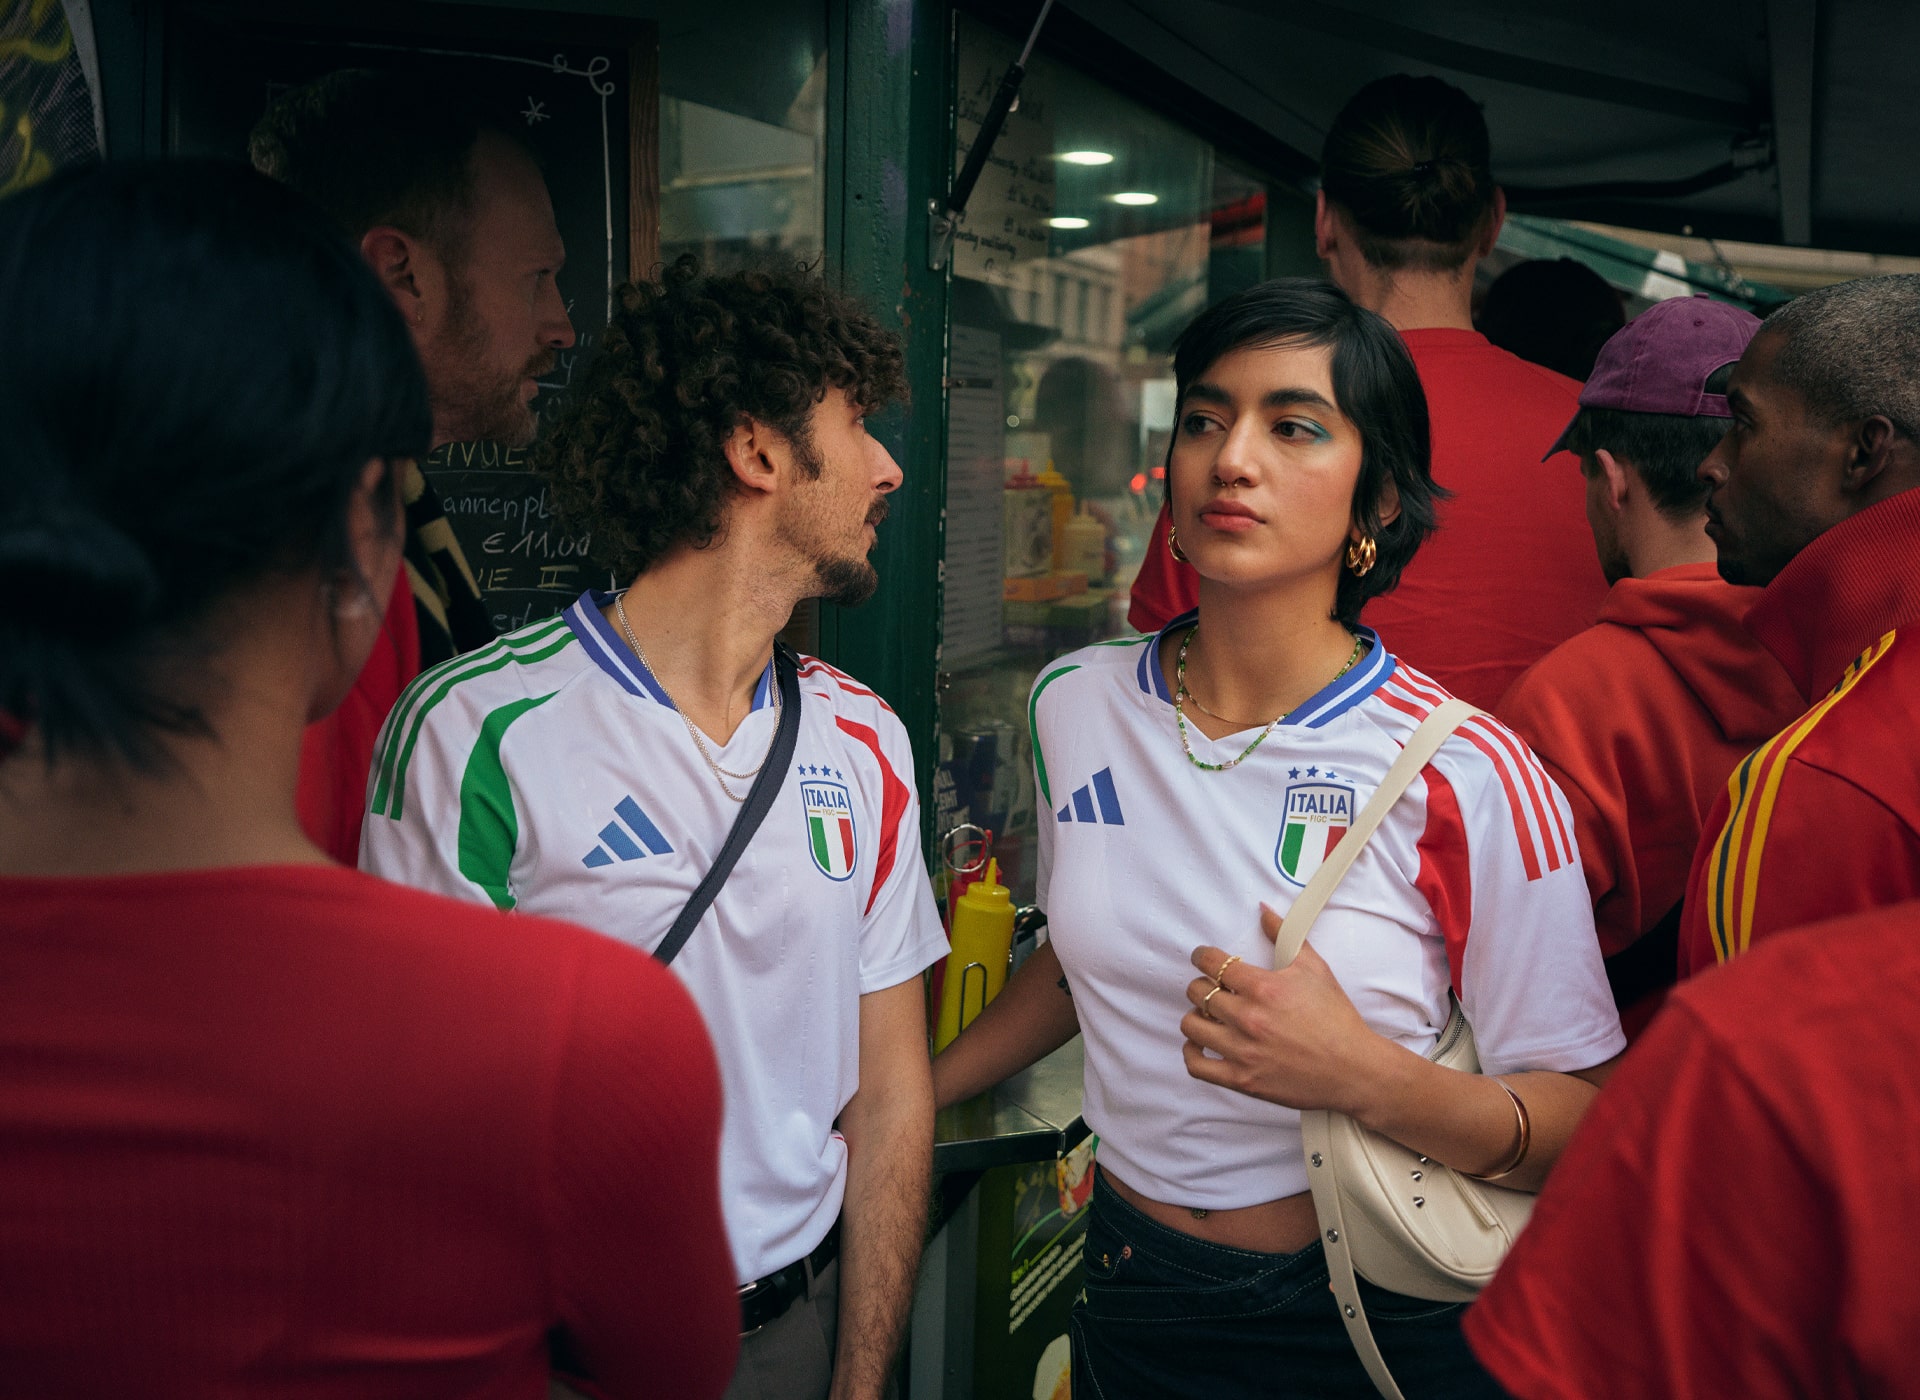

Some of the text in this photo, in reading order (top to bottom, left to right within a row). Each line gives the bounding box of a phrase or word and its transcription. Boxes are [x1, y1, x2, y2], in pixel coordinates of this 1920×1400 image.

[443, 487, 550, 537] annenpl
[804, 788, 847, 808] ITALIA
[1290, 793, 1348, 814] ITALIA
[1309, 815, 1328, 823] FIGC
